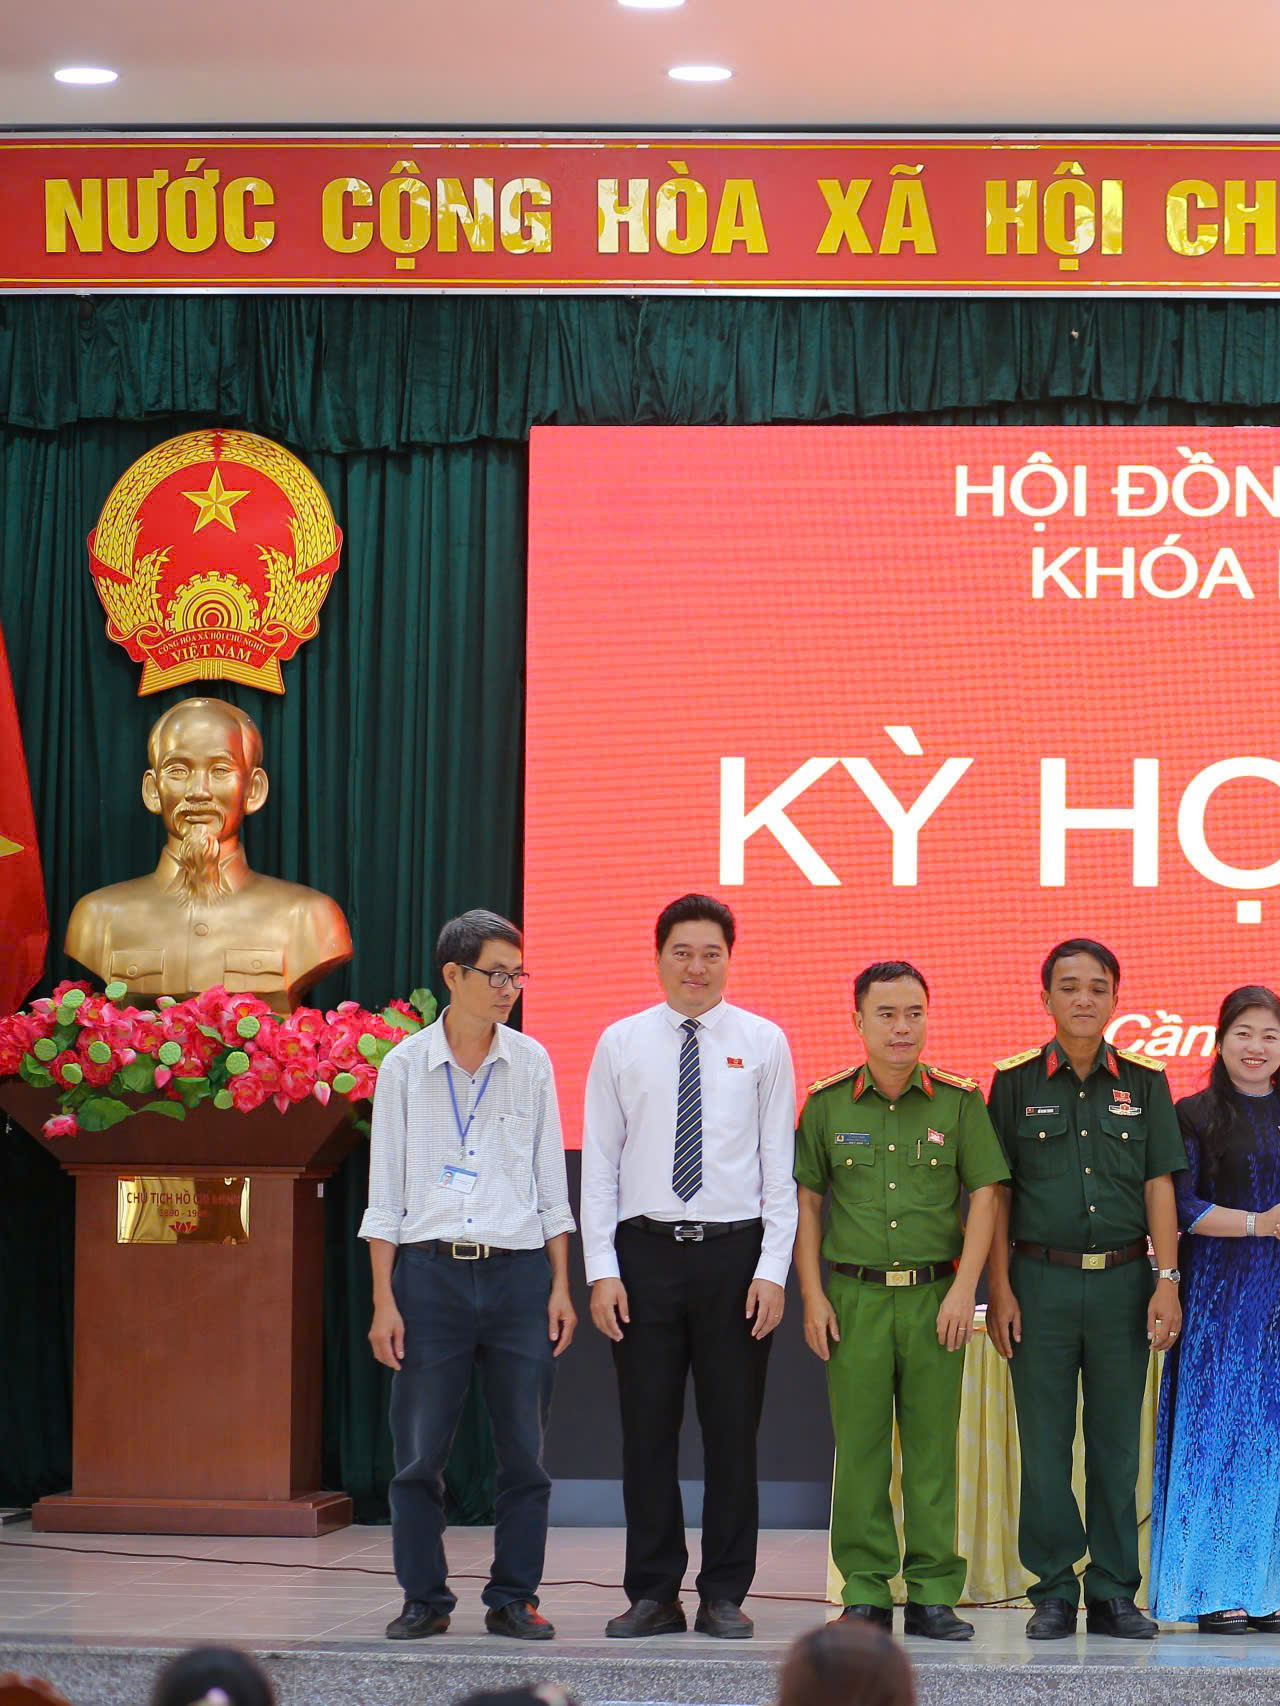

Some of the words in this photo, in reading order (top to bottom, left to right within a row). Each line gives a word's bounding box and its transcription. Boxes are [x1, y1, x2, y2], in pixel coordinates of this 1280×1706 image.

[45, 157, 276, 253] NƯỚC
[323, 159, 552, 269] CỘNG
[598, 160, 768, 254] HÒA
[816, 164, 937, 255] XÃ
[985, 161, 1124, 270] HỘI
[956, 452, 1086, 531] HỘI
[1032, 534, 1254, 600] KHÓA
[171, 642, 211, 662] VIỆT
[215, 643, 252, 662] NAM
[720, 726, 973, 886] KỲ
[1103, 1010, 1216, 1057] Cần
[150, 1192, 173, 1207] TỊCH
[175, 1188, 191, 1205] HỒ
